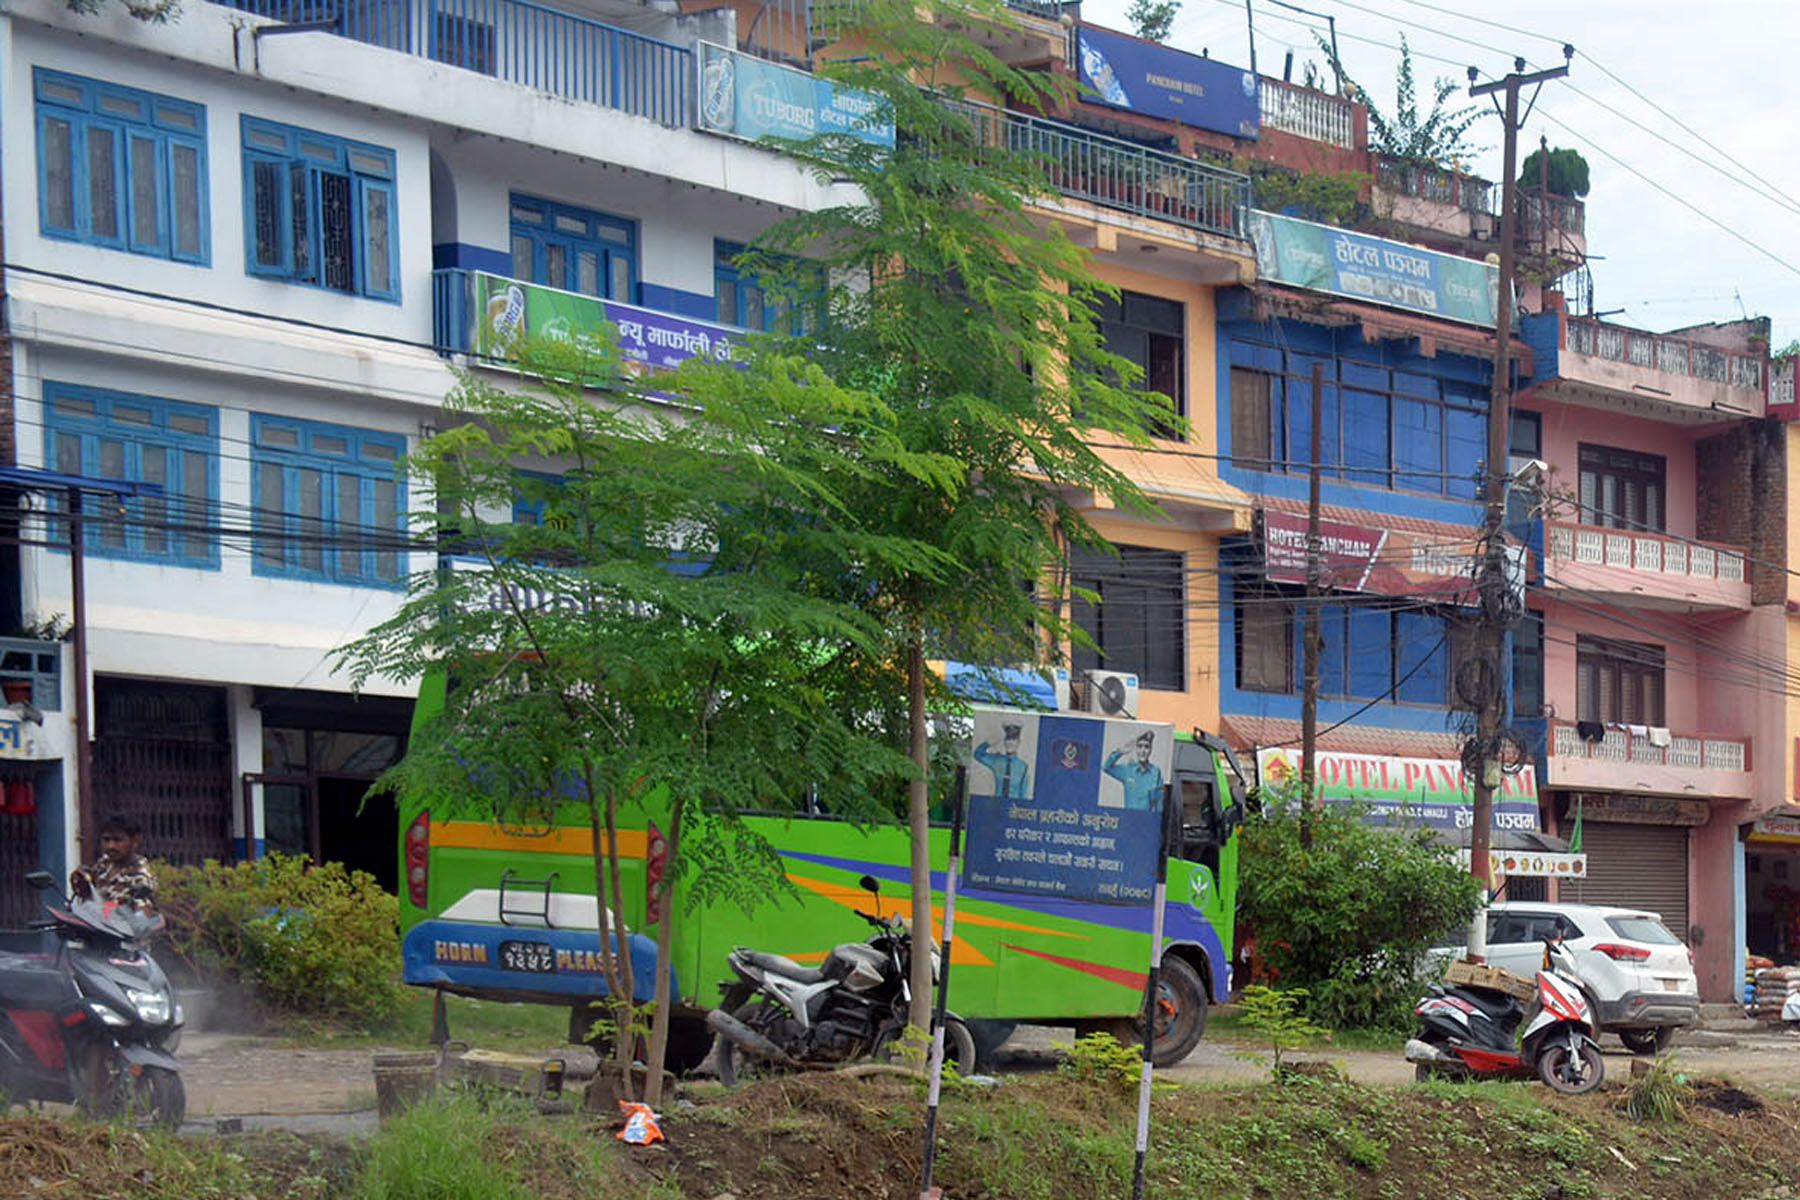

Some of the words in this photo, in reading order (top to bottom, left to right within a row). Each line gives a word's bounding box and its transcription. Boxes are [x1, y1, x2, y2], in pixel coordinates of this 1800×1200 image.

[753, 93, 815, 130] TUBORG
[1336, 235, 1380, 268] होटल
[618, 319, 643, 347] न्यू
[647, 325, 710, 355] मार्फाली
[1268, 527, 1309, 550] HOTEL
[1318, 534, 1371, 558] ANCHAM
[435, 940, 488, 963] HORN
